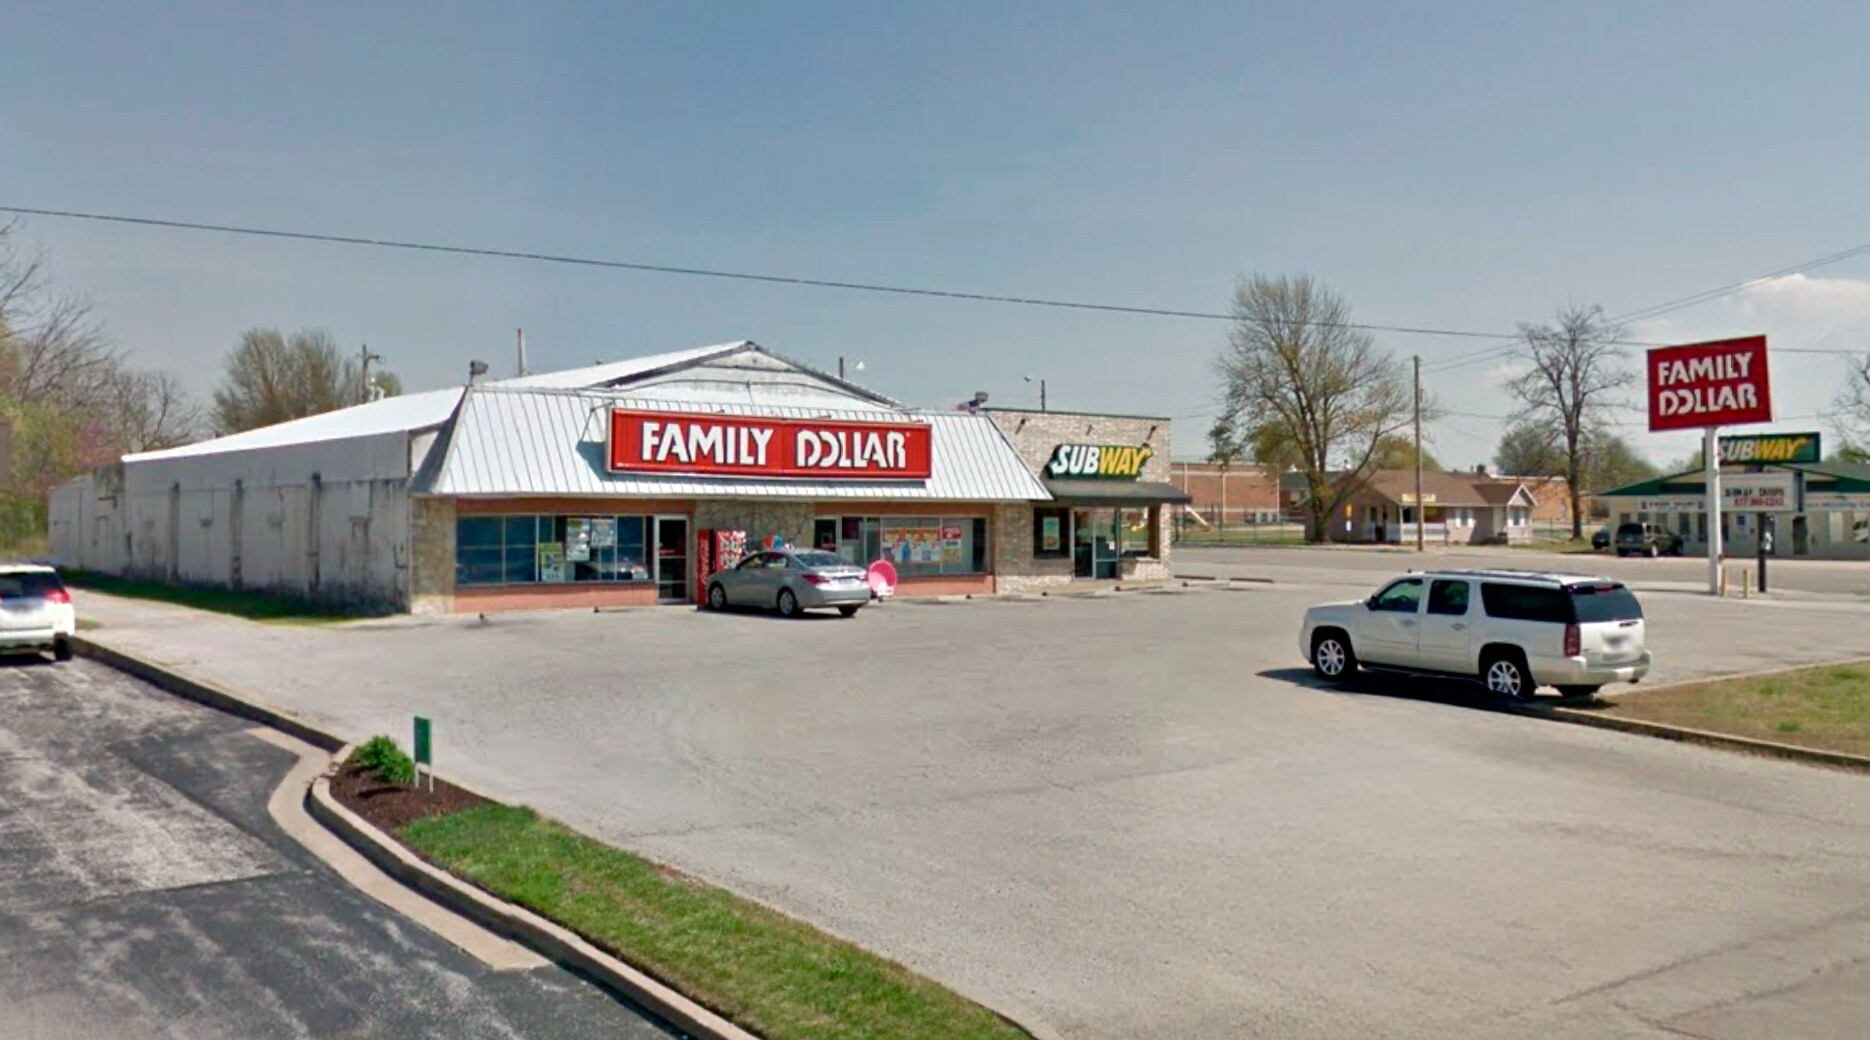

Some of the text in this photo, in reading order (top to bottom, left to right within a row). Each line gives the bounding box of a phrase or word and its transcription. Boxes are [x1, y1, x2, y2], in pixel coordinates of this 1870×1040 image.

[1657, 352, 1753, 386] FAMILY
[1658, 382, 1758, 416] DOLLAR
[642, 421, 907, 469] FAMILY DOLLAR
[1051, 445, 1154, 475] SUBWAY
[1719, 437, 1807, 462] SUBWAY
